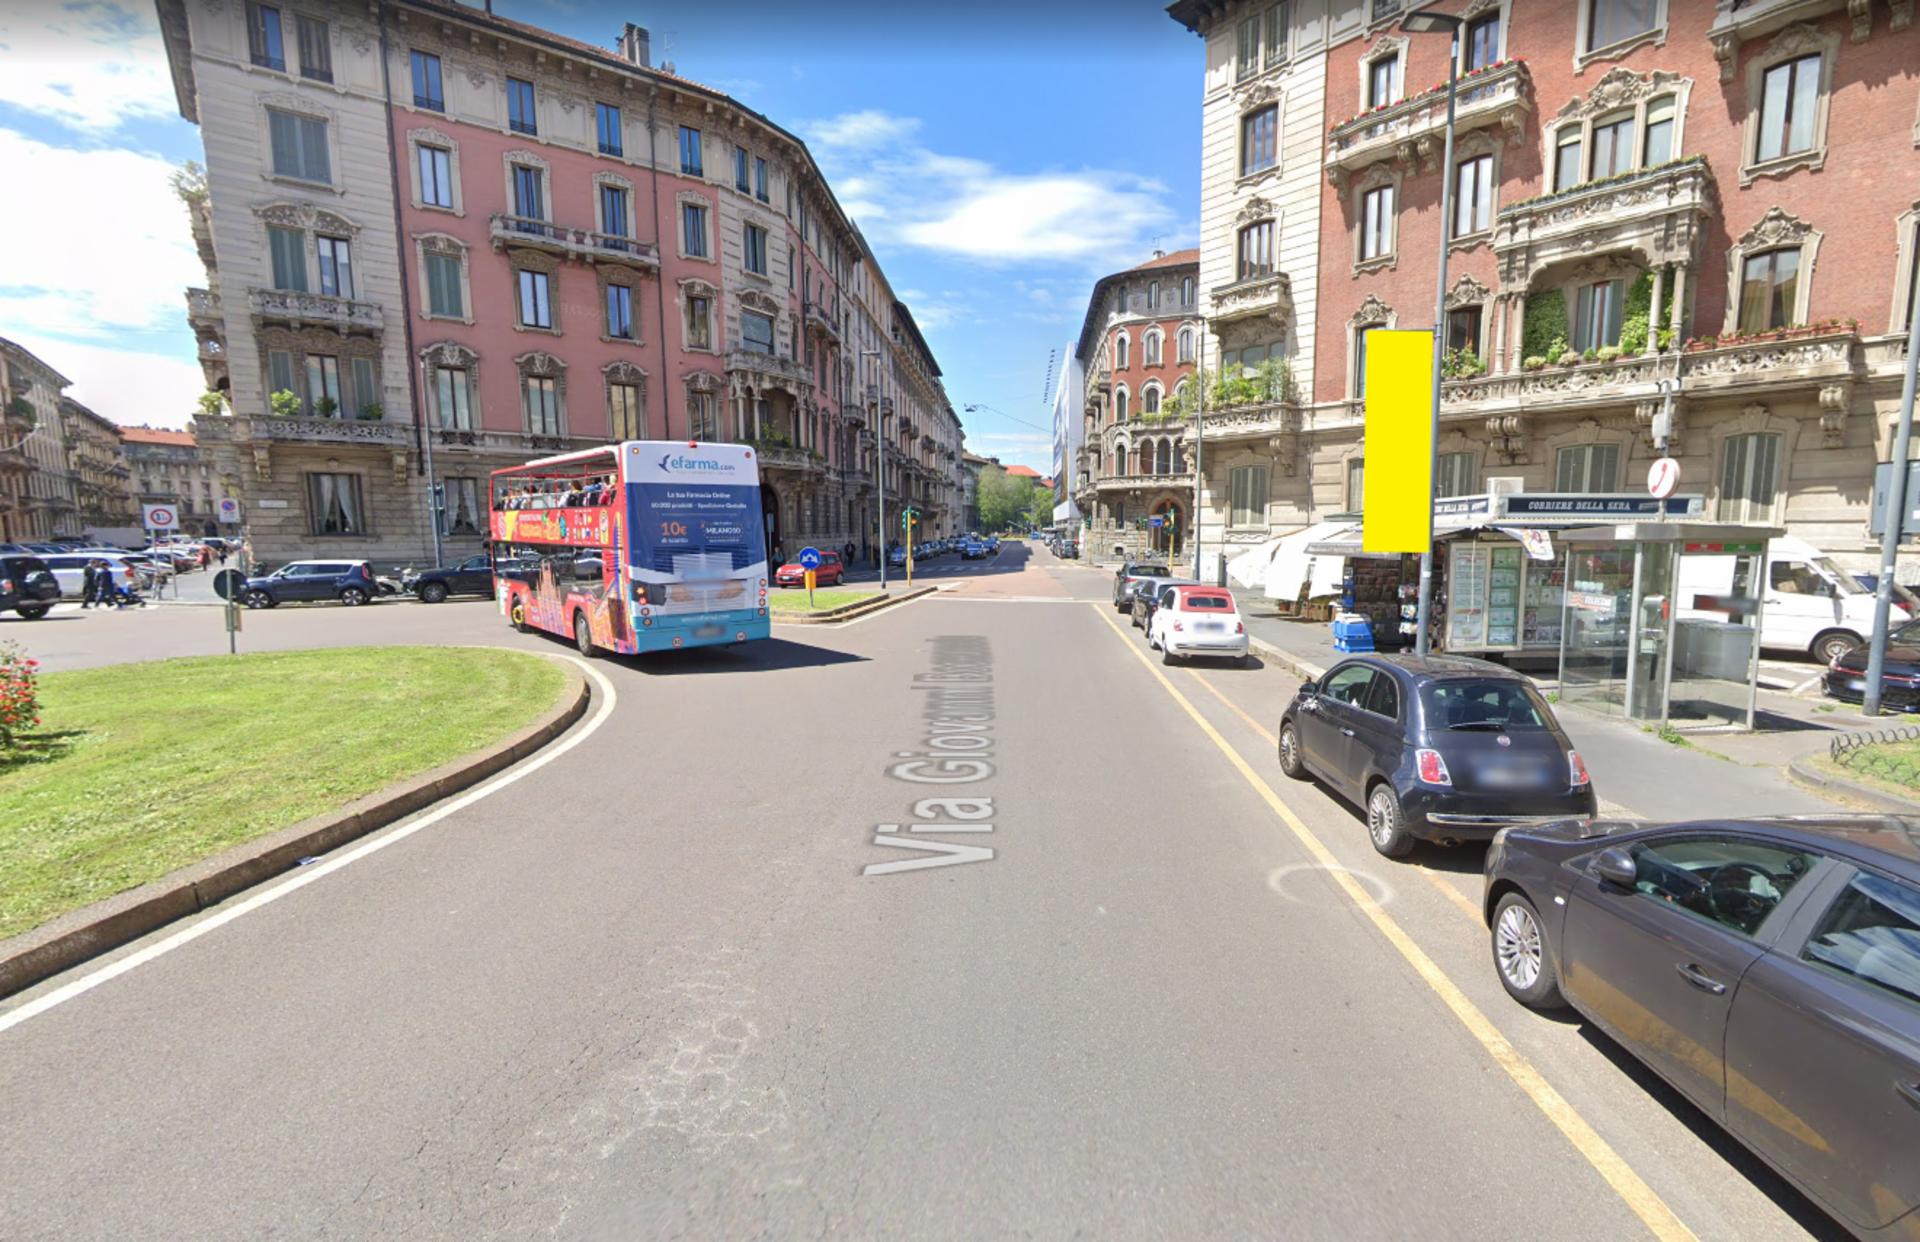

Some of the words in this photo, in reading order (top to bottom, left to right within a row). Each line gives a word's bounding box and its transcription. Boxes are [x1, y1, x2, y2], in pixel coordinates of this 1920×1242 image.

[671, 456, 735, 471] efarma.com
[1528, 501, 1572, 511] CORRIERE
[1575, 501, 1604, 511] DELLA
[1607, 501, 1631, 511] SERA
[661, 522, 688, 536] 10€
